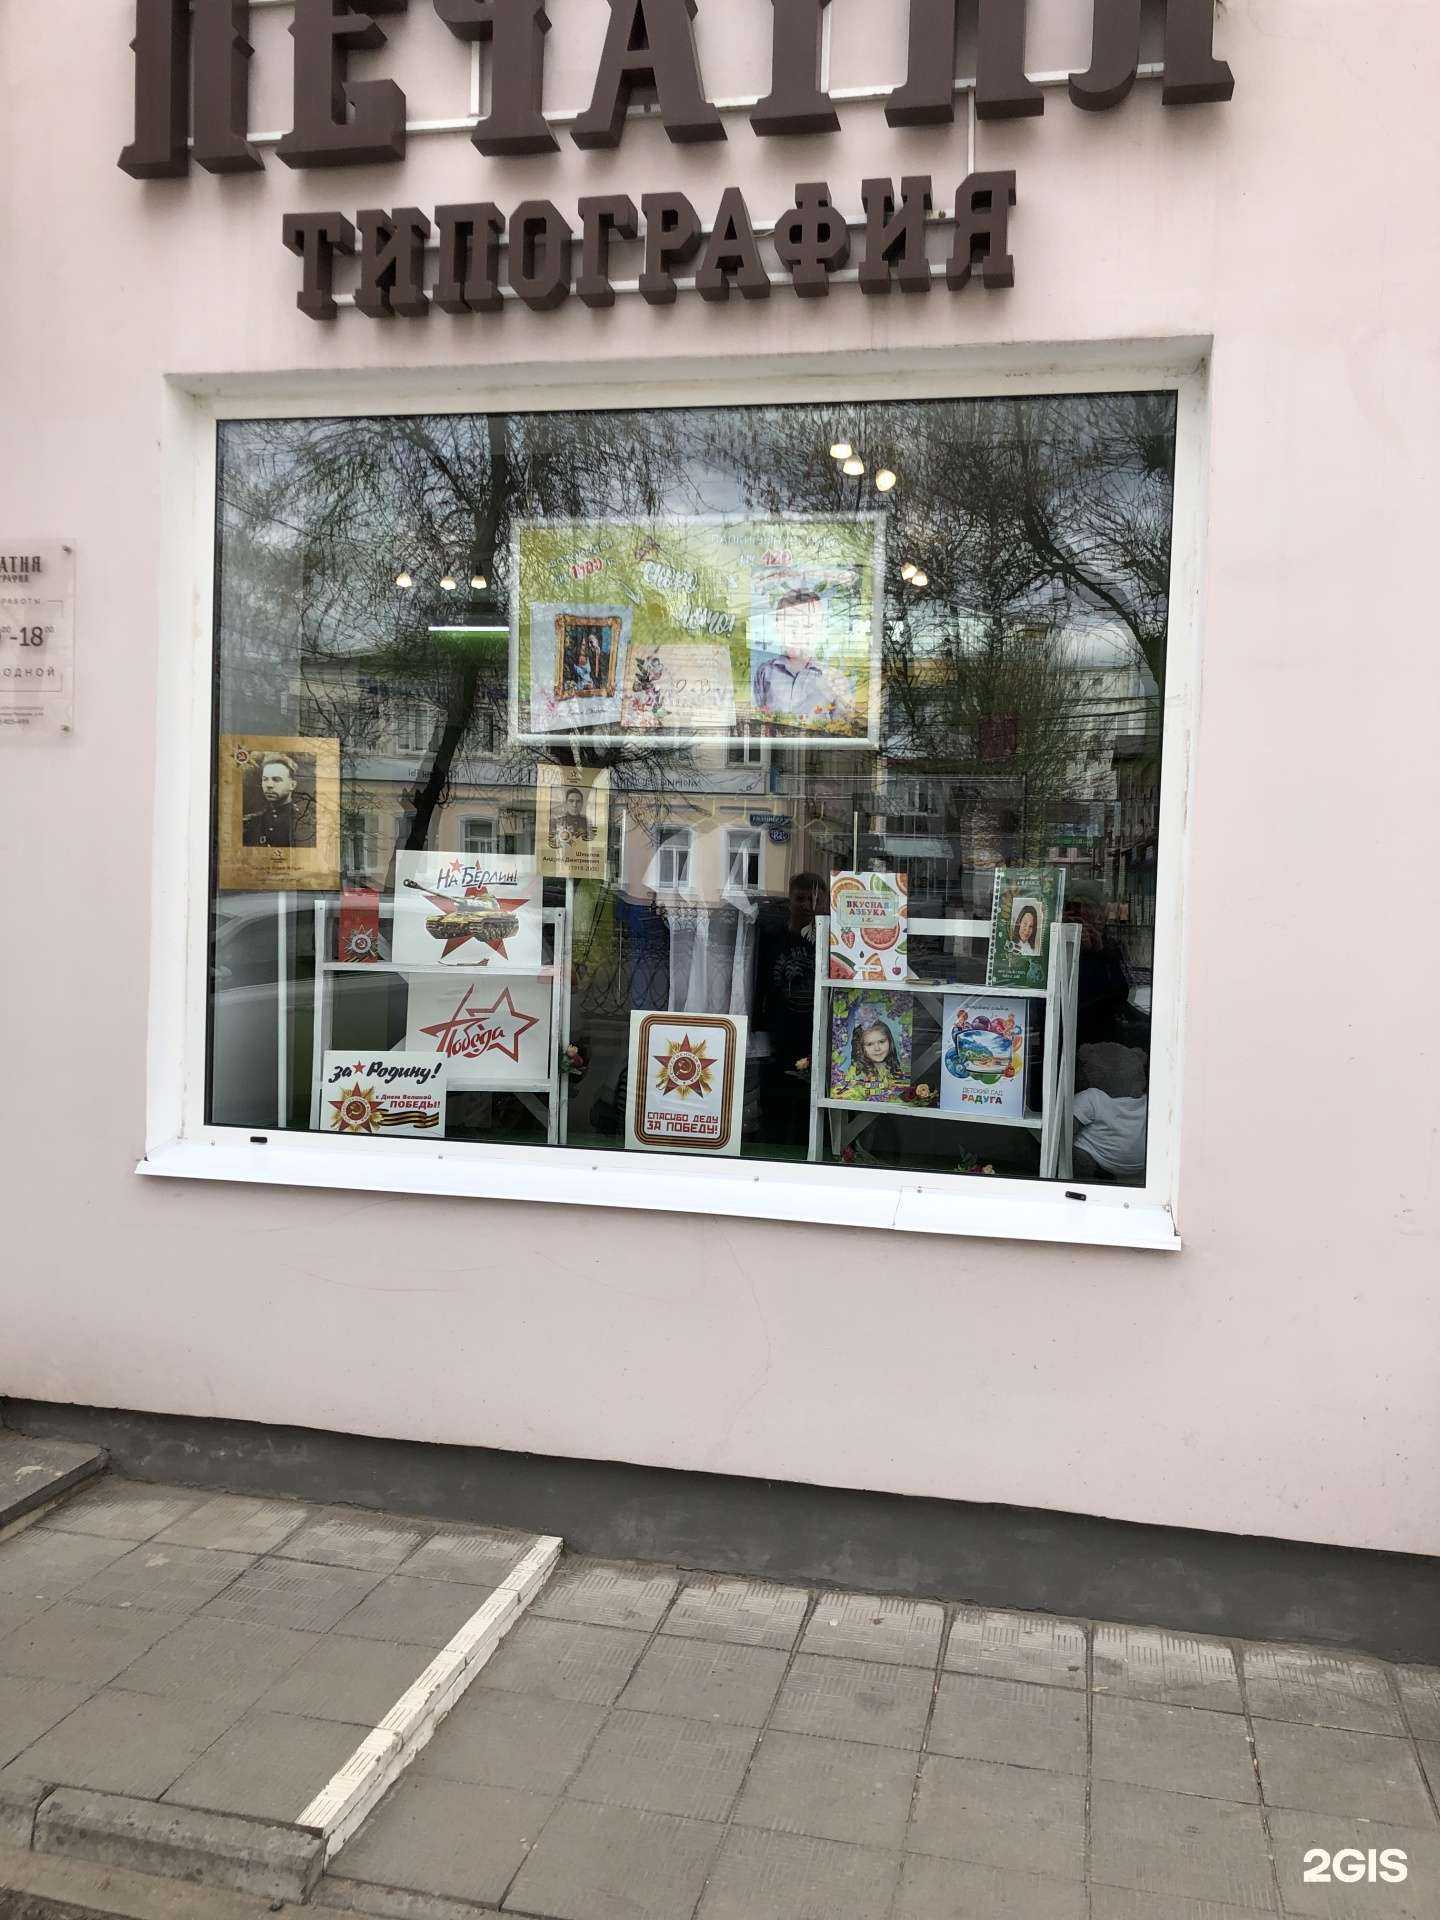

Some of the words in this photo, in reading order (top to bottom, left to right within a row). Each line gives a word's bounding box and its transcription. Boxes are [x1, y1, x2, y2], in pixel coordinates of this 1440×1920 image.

[282, 169, 1017, 321] ТИПОГРАФИЯ
[0, 664, 55, 677] ОДНОЙ
[846, 900, 892, 909] ВКУСНАЯ
[422, 1016, 506, 1058] Победа
[366, 1061, 442, 1084] Родину!
[961, 1093, 1003, 1105] РАДУГА
[647, 1111, 689, 1122] СПАСИБО
[693, 1114, 719, 1124] ДЕДУ
[647, 1120, 661, 1131] ЗА
[666, 1121, 718, 1135] ПОБЕДУ!
